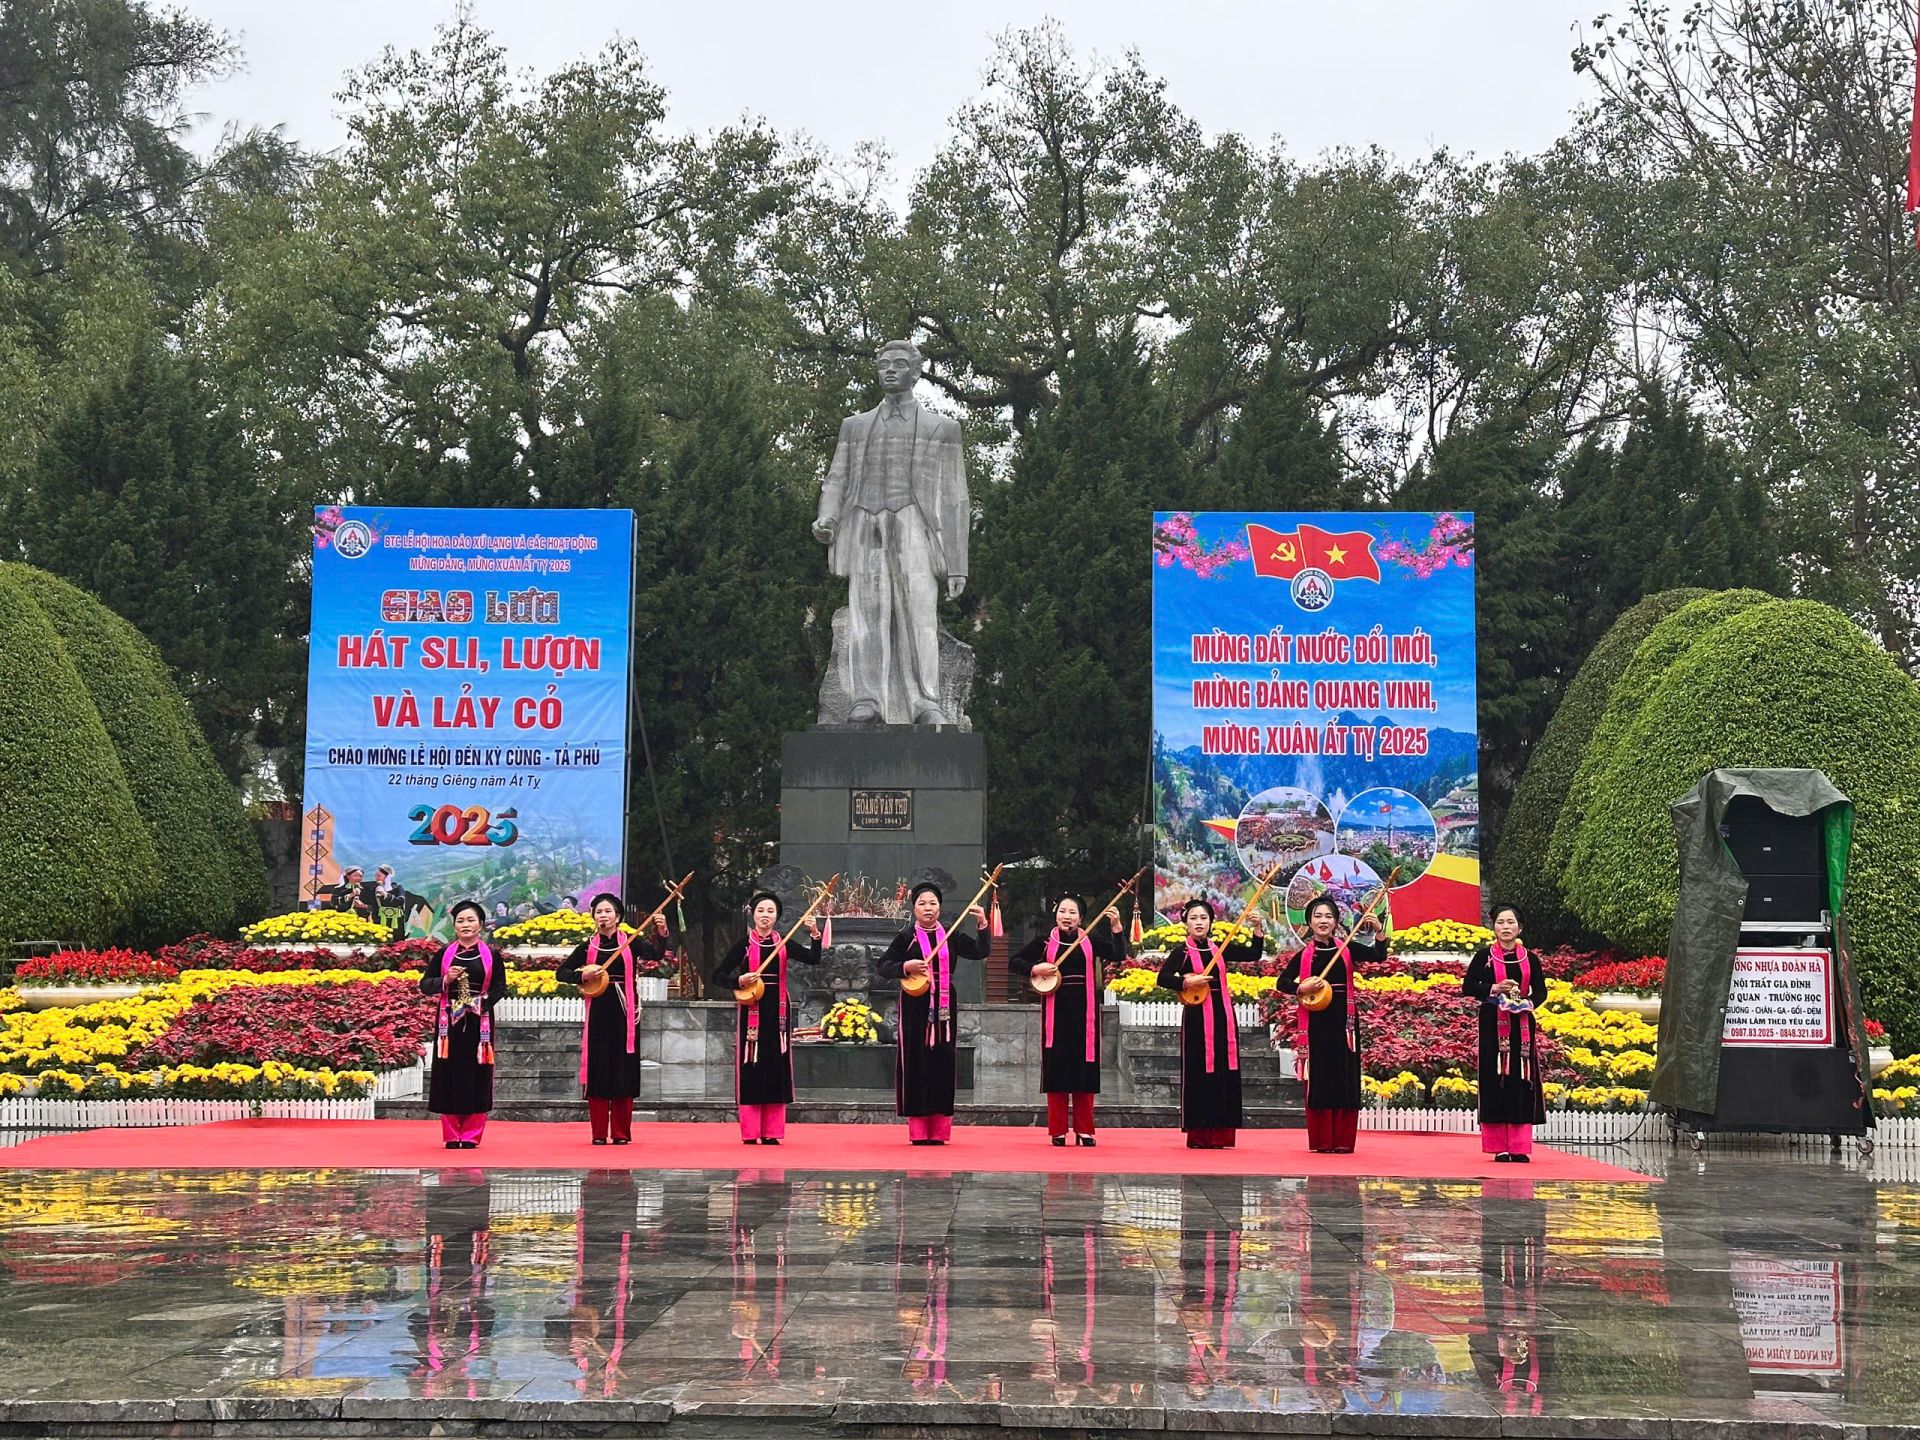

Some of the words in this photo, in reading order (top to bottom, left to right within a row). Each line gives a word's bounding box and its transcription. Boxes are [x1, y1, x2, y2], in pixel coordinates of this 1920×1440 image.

[384, 535, 401, 548] BTC
[403, 530, 414, 548] LỄ
[415, 533, 430, 551] HỘI
[432, 536, 450, 548] HOA
[473, 533, 486, 549] XỨ
[487, 536, 511, 552] LẠNG
[513, 534, 526, 549] VÀ
[527, 534, 546, 549] CÁC
[547, 537, 570, 553] HOẠT
[571, 534, 597, 553] ĐỘNG
[410, 554, 437, 570] MỪNG
[468, 555, 494, 571] MỪNG
[496, 556, 521, 571] XUÂN
[536, 559, 547, 576] TỴ
[549, 560, 570, 572] 2025
[382, 590, 474, 623] GIAO
[338, 630, 409, 668] HÁT
[421, 636, 489, 673] SLI,
[503, 635, 600, 677] LƯỢN
[1193, 628, 1250, 662] MỪNG
[1255, 626, 1291, 662] ĐẤT
[1297, 627, 1350, 663] NƯỚC
[1355, 625, 1387, 663] ĐỔI
[1393, 627, 1437, 666] MỚI,
[1193, 674, 1250, 708] MỪNG
[1256, 669, 1309, 708] ĐẢNG
[1315, 681, 1380, 711] QUANG
[1385, 681, 1437, 711] VINH,
[373, 689, 420, 728] VÀ
[433, 683, 501, 728] LẢY
[513, 684, 562, 730] CỎ
[1203, 720, 1260, 754] MỪNG
[1266, 721, 1318, 754] XUÂN
[1324, 717, 1347, 754] ẤT
[1353, 727, 1375, 760] TỴ
[1381, 727, 1428, 754] 2025
[328, 745, 363, 765] CHÀO
[367, 745, 406, 765] MỪNG
[411, 743, 425, 765] LỄ
[429, 746, 451, 769] HỘI
[455, 744, 480, 765] ĐỀN
[485, 746, 501, 765] KỲ
[506, 746, 541, 765] CÙNG
[555, 742, 570, 765] TẢ
[574, 742, 600, 765] PHỦ
[388, 773, 402, 785] 22
[405, 773, 439, 788] tháng
[443, 774, 477, 789] Giêng
[480, 775, 506, 786] năm
[527, 775, 541, 789] Tỵ
[408, 804, 519, 847] 2025
[1755, 960, 1779, 974] NHỰA
[1729, 992, 1735, 1001] Ơ
[1737, 993, 1760, 1002] QUAN
[1769, 992, 1802, 1002] TRƯỜNG
[1805, 994, 1821, 1004] HỌC
[1733, 978, 1748, 989] NỘI
[1750, 977, 1771, 988] THẤT
[1774, 980, 1788, 988] GIA
[1791, 978, 1811, 988] ĐÌNH
